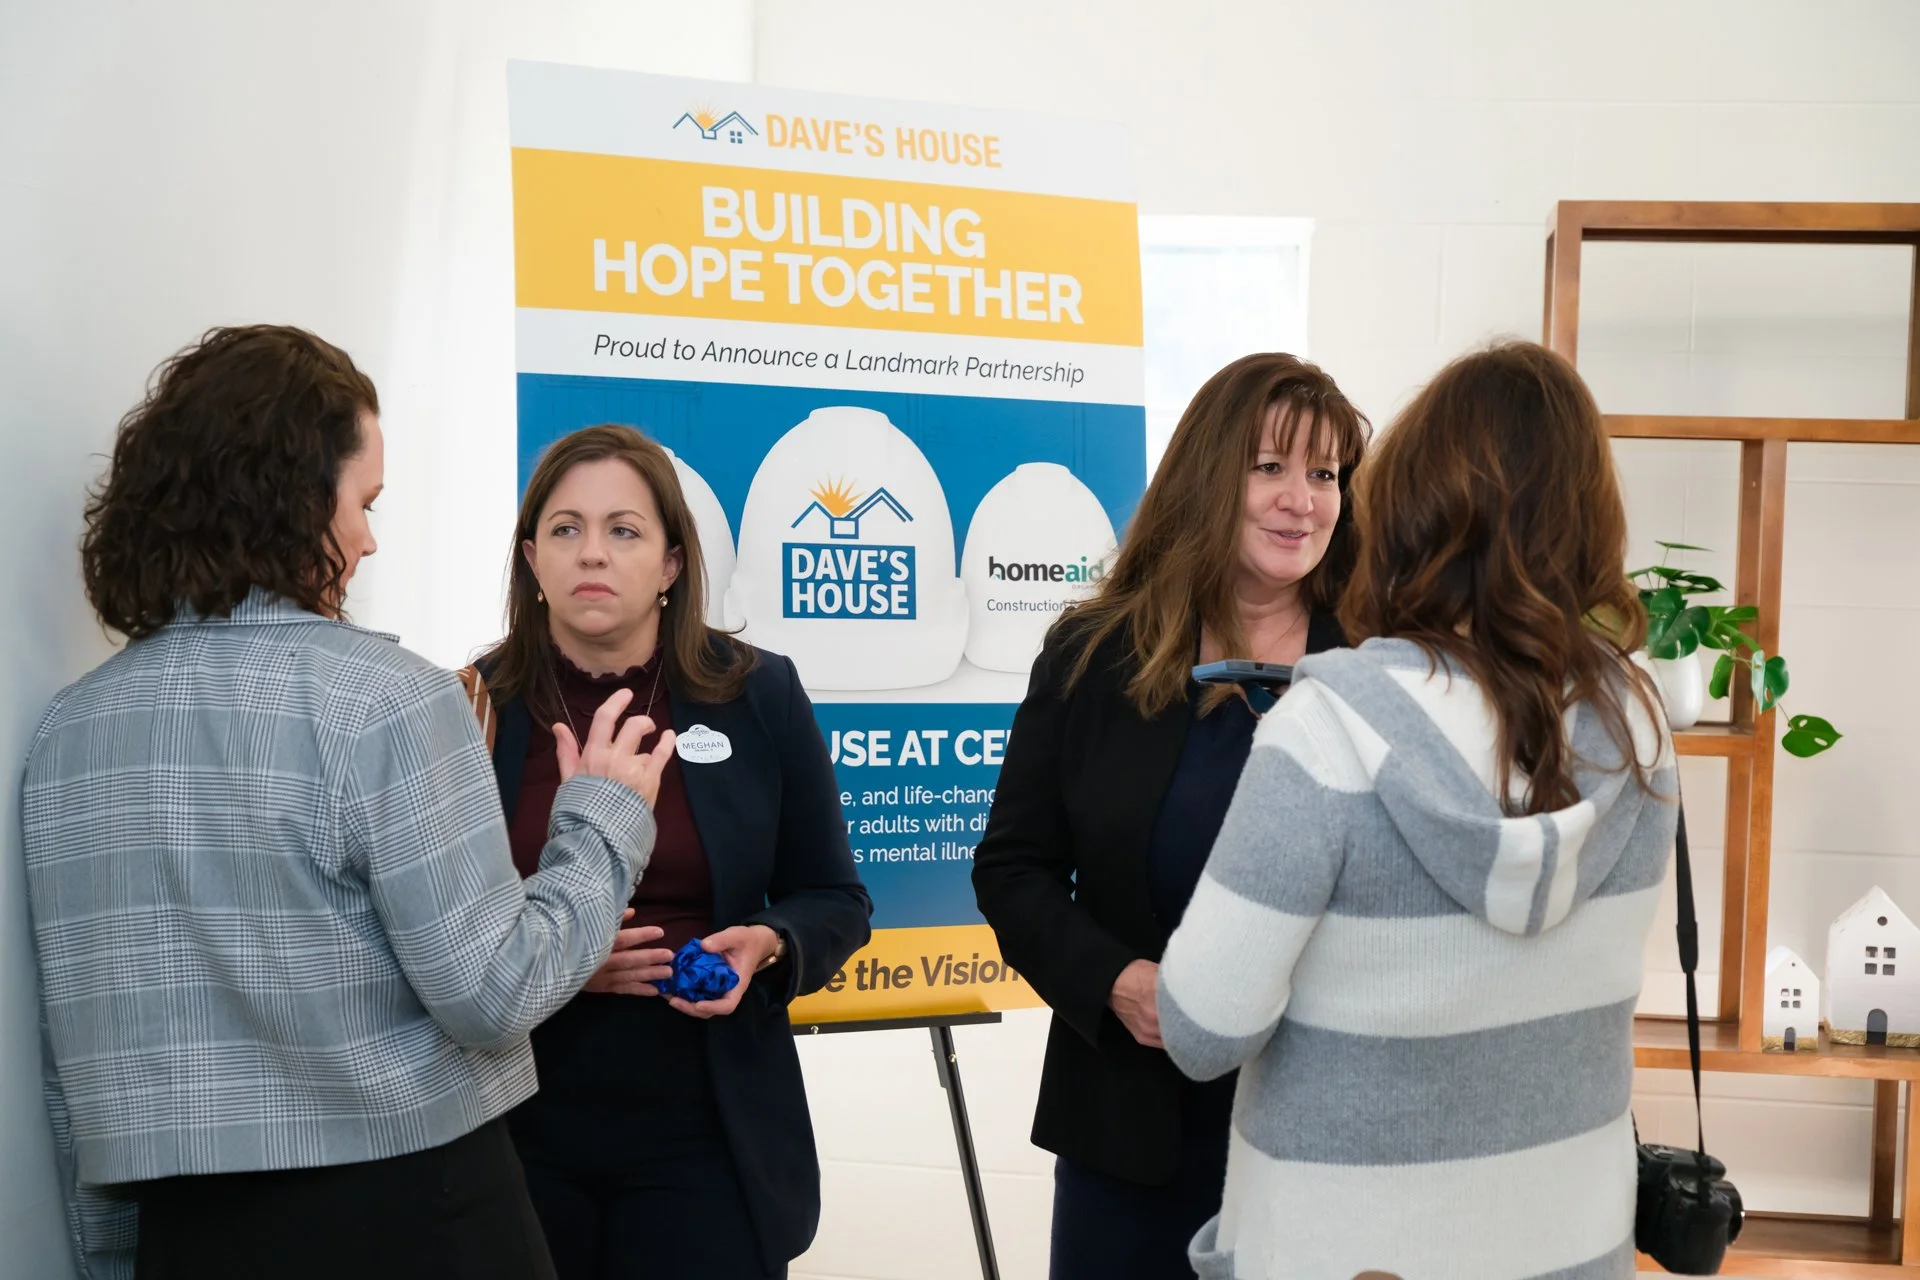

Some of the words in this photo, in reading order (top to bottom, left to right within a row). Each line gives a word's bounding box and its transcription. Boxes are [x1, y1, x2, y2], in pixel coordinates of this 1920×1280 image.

[766, 114, 884, 158] DAVE'S
[897, 128, 1002, 168] HOUSE
[702, 186, 985, 258] BUILDING
[593, 239, 764, 302] HOPE
[774, 253, 1084, 324] TOGETHER
[594, 334, 667, 359] Proud
[673, 339, 696, 361] to
[701, 341, 818, 368] Announce
[824, 353, 839, 369] a
[846, 349, 959, 376] Landmark
[965, 357, 1085, 388] Partnership
[791, 547, 909, 582] DAVE'S
[988, 556, 1104, 582] homeaid
[791, 583, 909, 615] HOUSE
[987, 599, 1066, 612] Construction
[682, 742, 724, 750] MEGHAN
[897, 730, 948, 766] AT
[954, 729, 1012, 766] CE
[862, 786, 899, 805] and
[859, 815, 920, 834] adults
[924, 813, 965, 832] with
[969, 812, 989, 832] di
[869, 843, 937, 863] mental
[855, 957, 914, 991] the
[920, 952, 1020, 987] Vision
